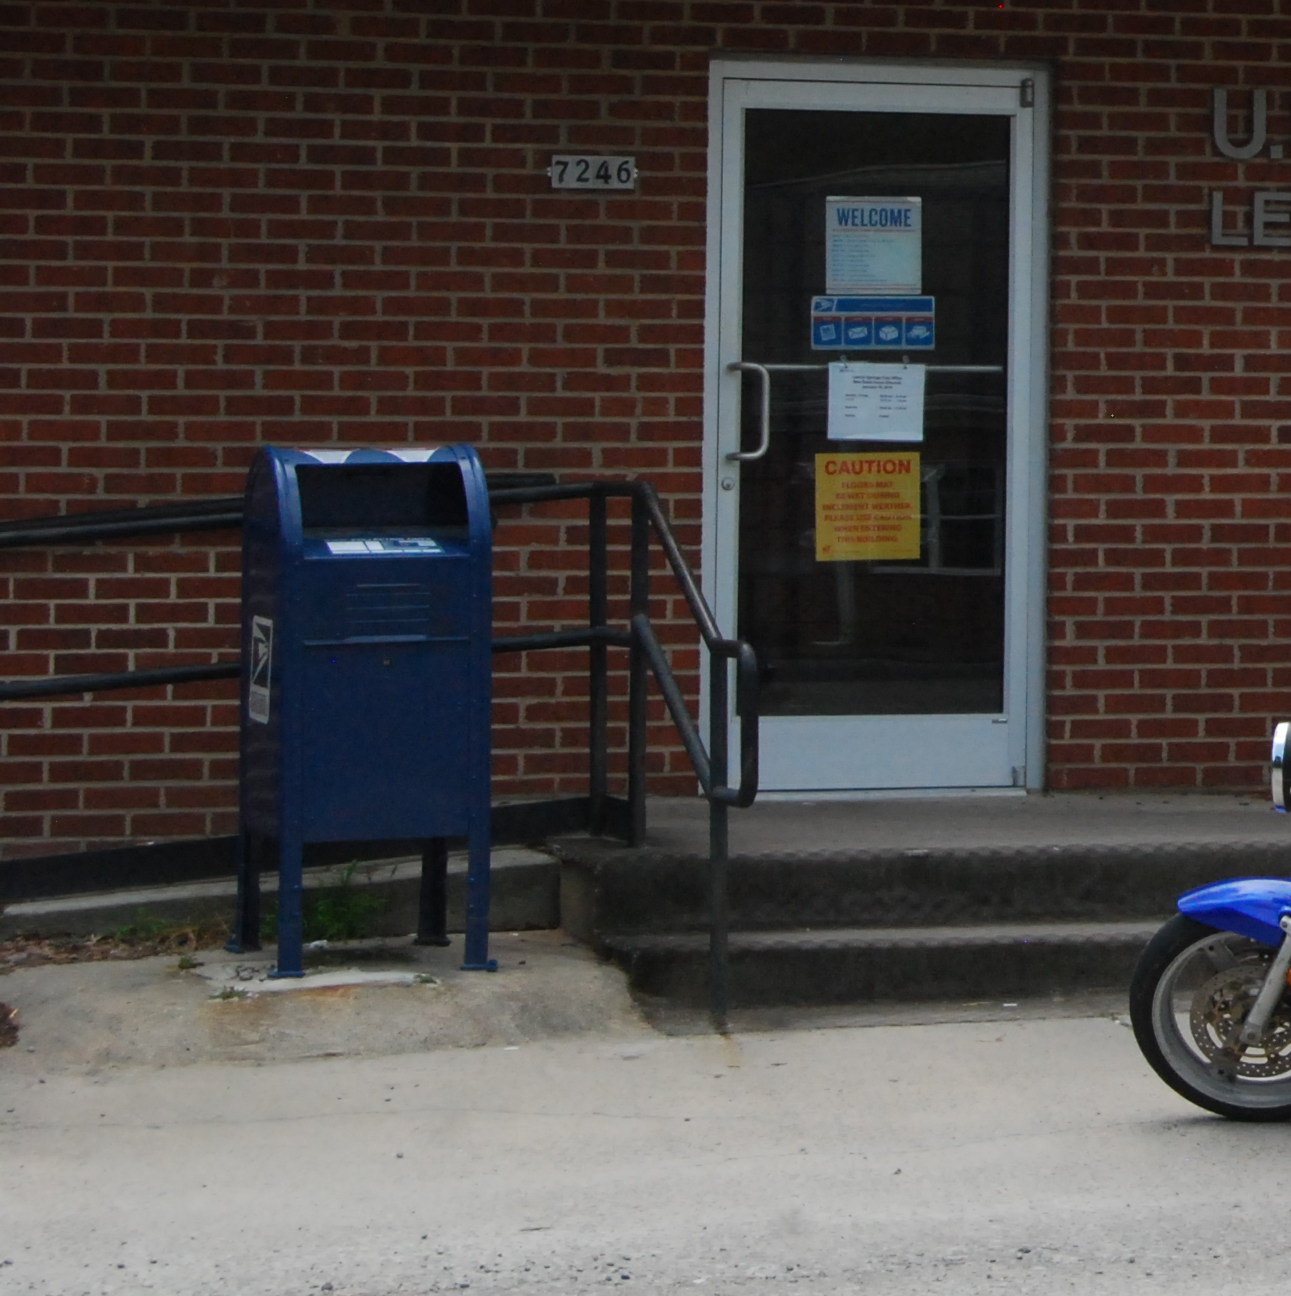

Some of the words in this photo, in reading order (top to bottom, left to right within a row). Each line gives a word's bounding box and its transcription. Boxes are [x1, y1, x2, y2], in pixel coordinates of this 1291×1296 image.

[554, 159, 632, 184] 7246
[836, 207, 913, 228] WELCOME
[824, 459, 912, 476] CAUTION
